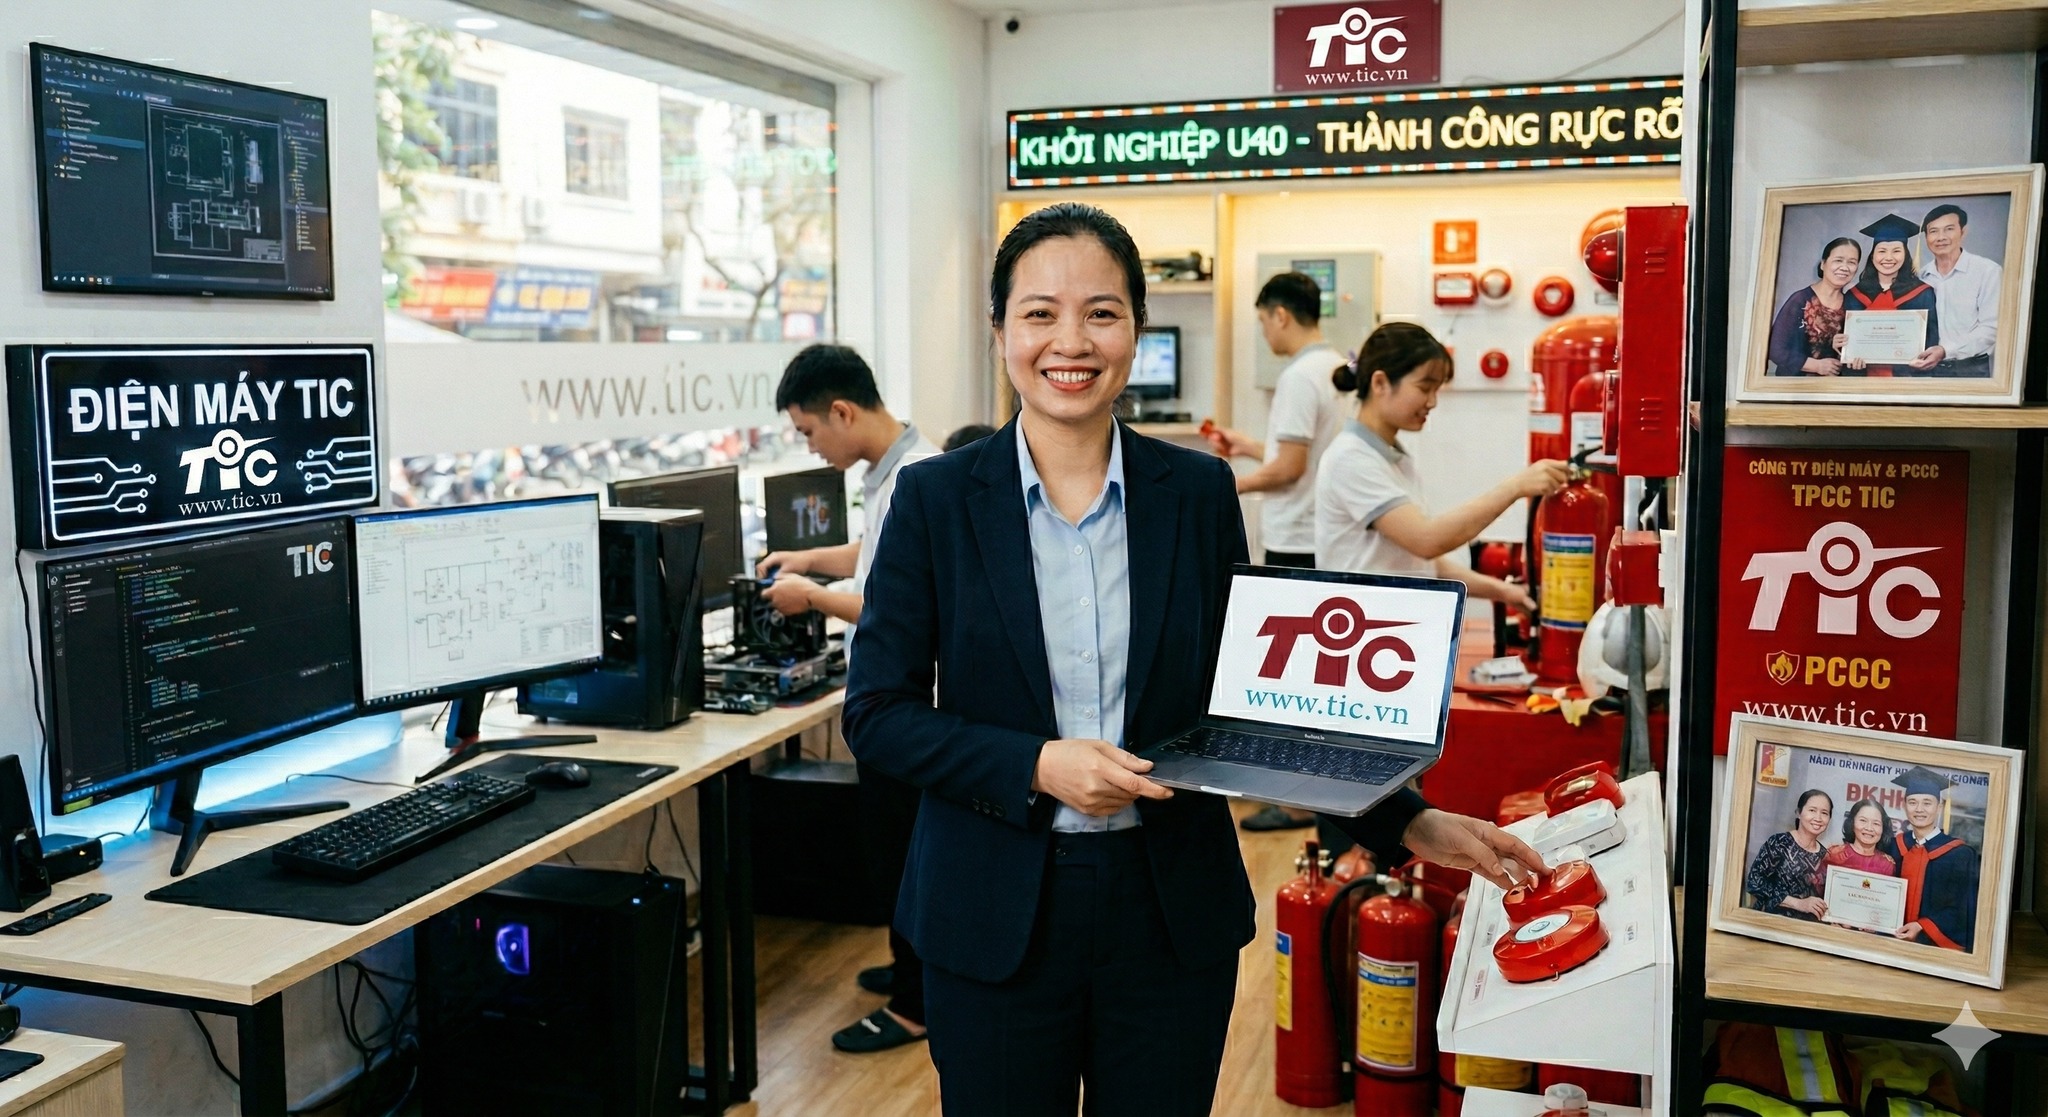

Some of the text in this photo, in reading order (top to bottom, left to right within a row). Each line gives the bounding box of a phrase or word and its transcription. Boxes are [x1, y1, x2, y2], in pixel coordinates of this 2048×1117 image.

[1305, 67, 1408, 85] www.tic.vn
[1020, 126, 1096, 166] KHỞI
[1104, 120, 1221, 166] NGHIỆP
[1227, 125, 1289, 158] U40
[1317, 110, 1432, 153] THÀNH
[1441, 105, 1540, 148] CÔNG
[1550, 105, 1626, 149] RỰC
[67, 370, 355, 441] ĐIỆN MÁY TIC
[1749, 458, 1940, 479] CÔNG TY ĐIỆN MÁY & PCCC
[178, 491, 283, 516] www.tic.vn
[1792, 484, 1896, 509] TPCC TIC
[1805, 656, 1892, 690] PCCC
[1245, 689, 1409, 725] www.tic.vn
[1742, 700, 1928, 732] www.tic.vn
